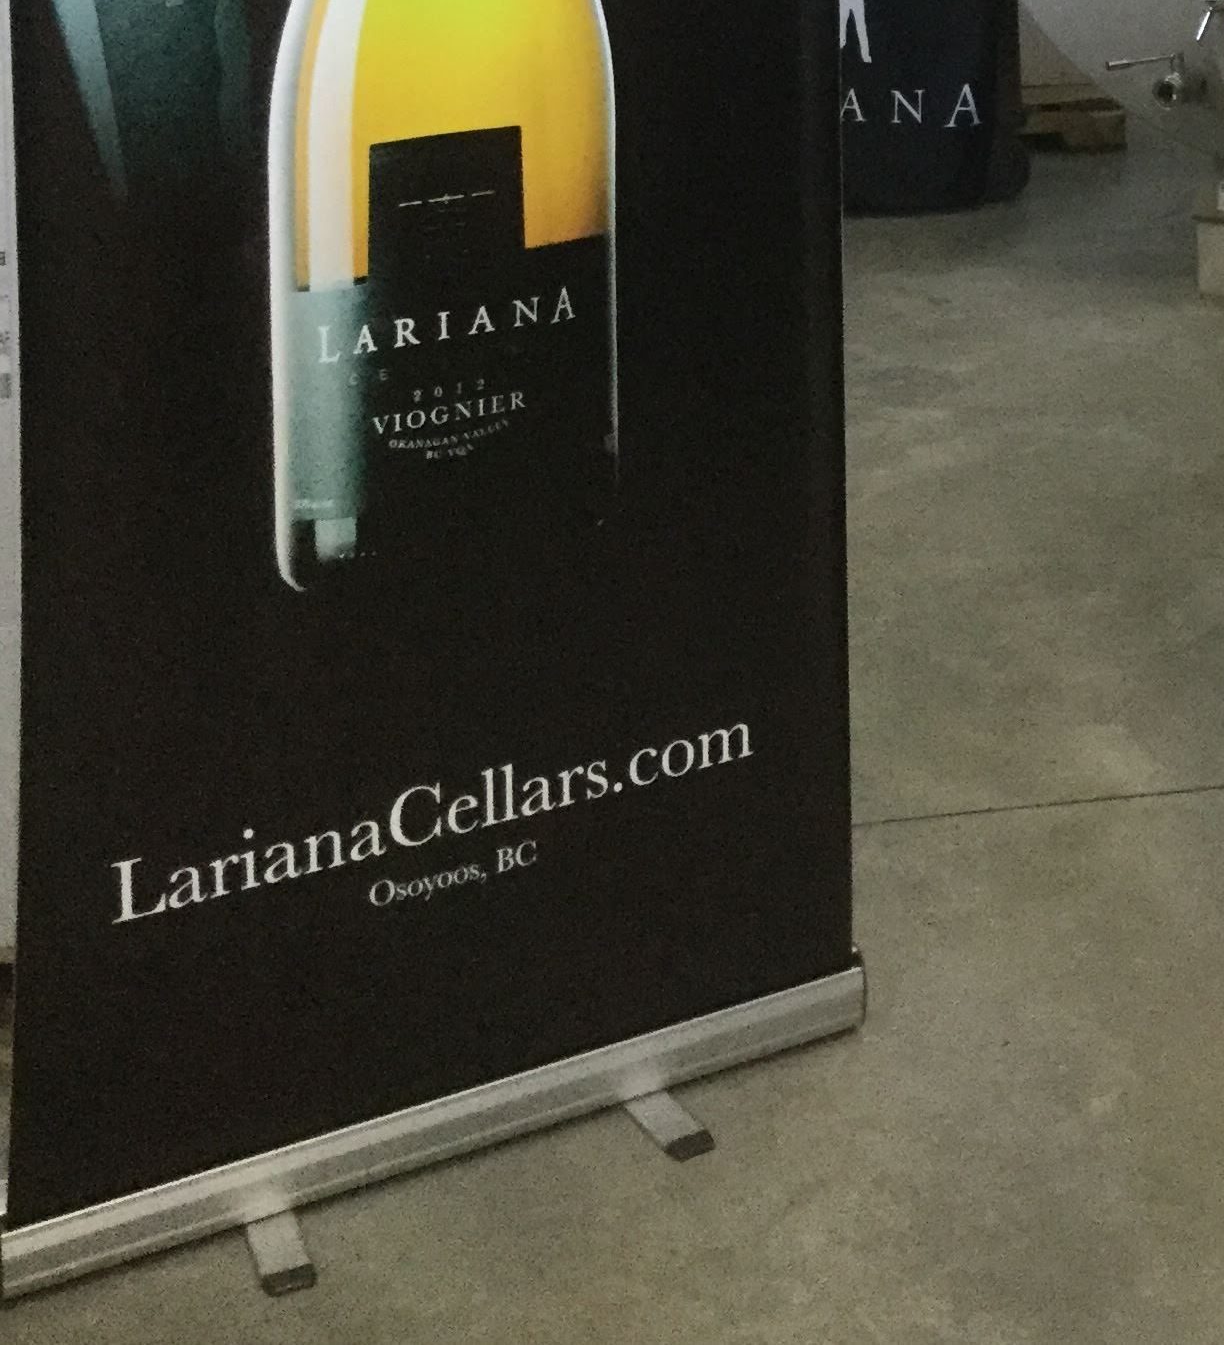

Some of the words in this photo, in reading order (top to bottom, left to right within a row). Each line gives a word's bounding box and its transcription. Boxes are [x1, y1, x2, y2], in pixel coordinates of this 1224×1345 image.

[317, 285, 577, 364] LARIANA
[371, 391, 526, 435] VIOGNIER
[110, 721, 754, 924] LarianaCellars.com
[369, 863, 487, 906] Osoyoos,
[496, 839, 538, 874] BC
